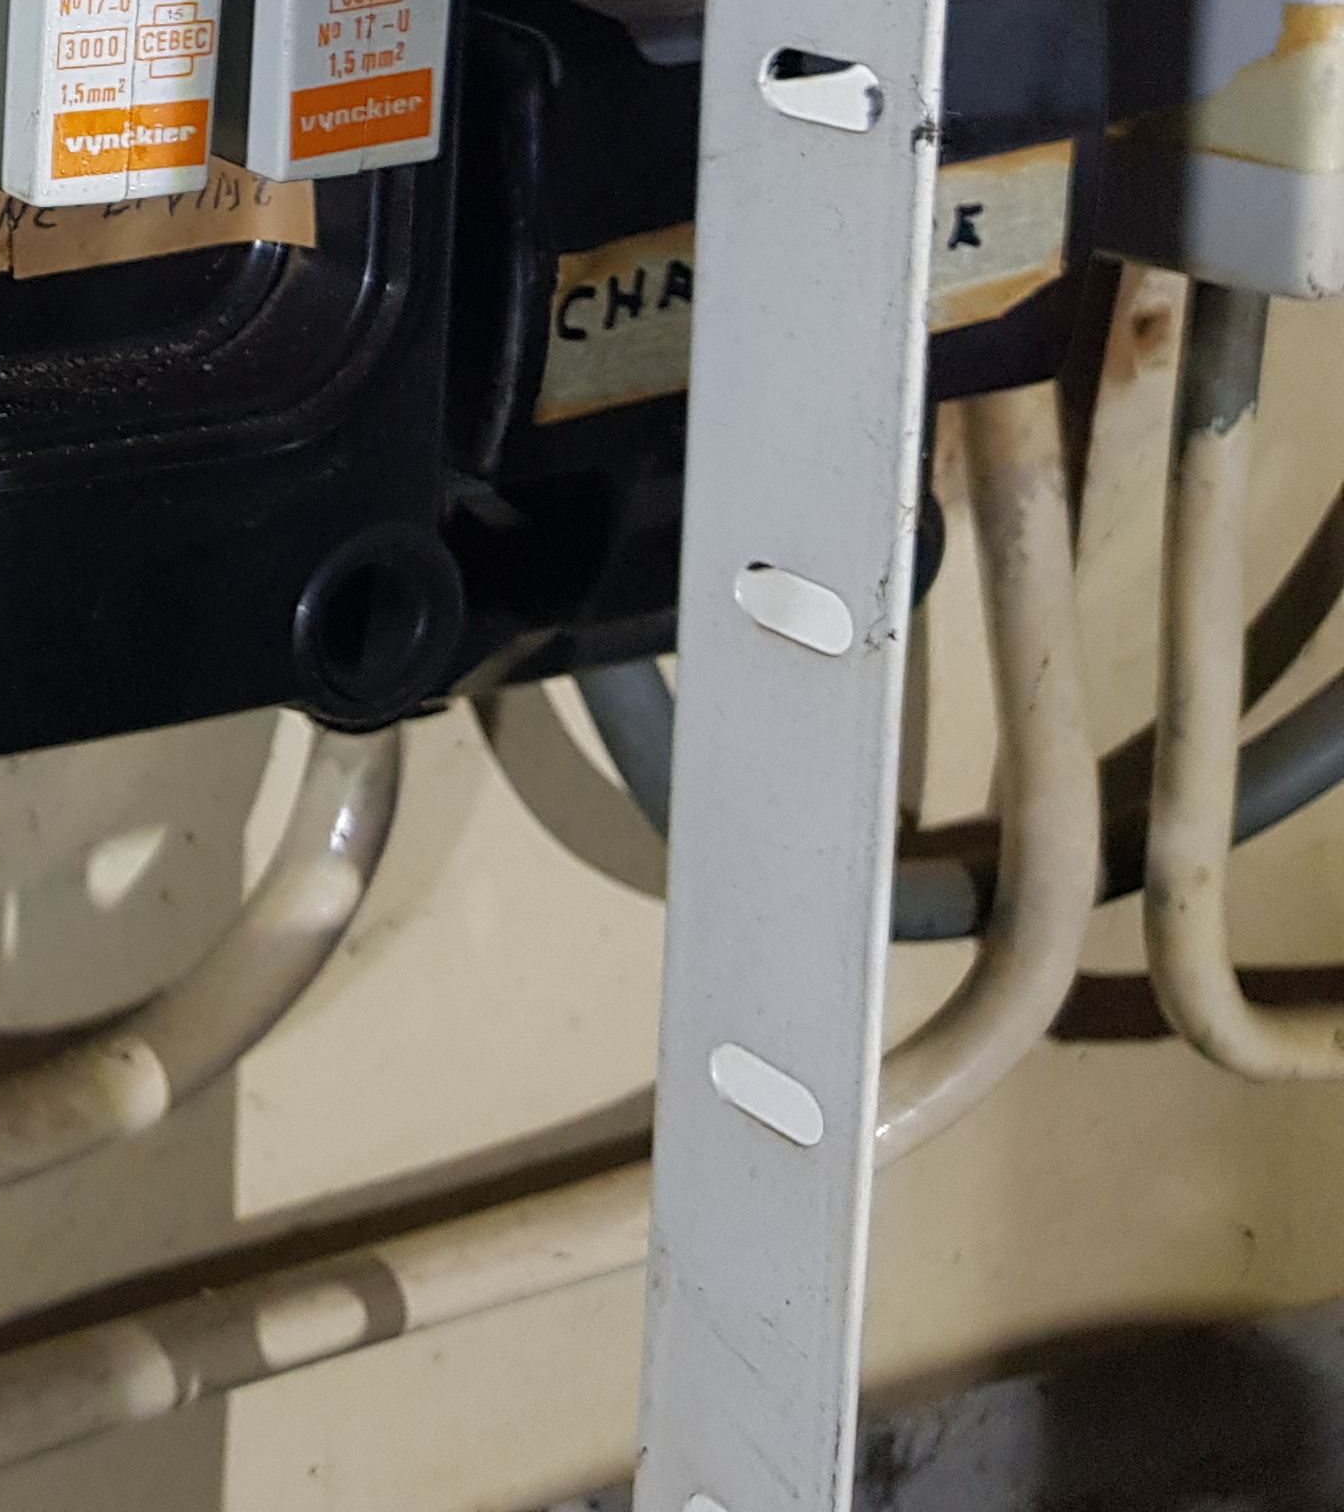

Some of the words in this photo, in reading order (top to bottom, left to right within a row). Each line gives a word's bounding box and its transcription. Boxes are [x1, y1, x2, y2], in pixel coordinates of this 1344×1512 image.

[65, 36, 118, 60] 3000
[142, 27, 208, 53] CEBEC
[300, 95, 423, 133] vynckier
[65, 124, 196, 156] vynckier
